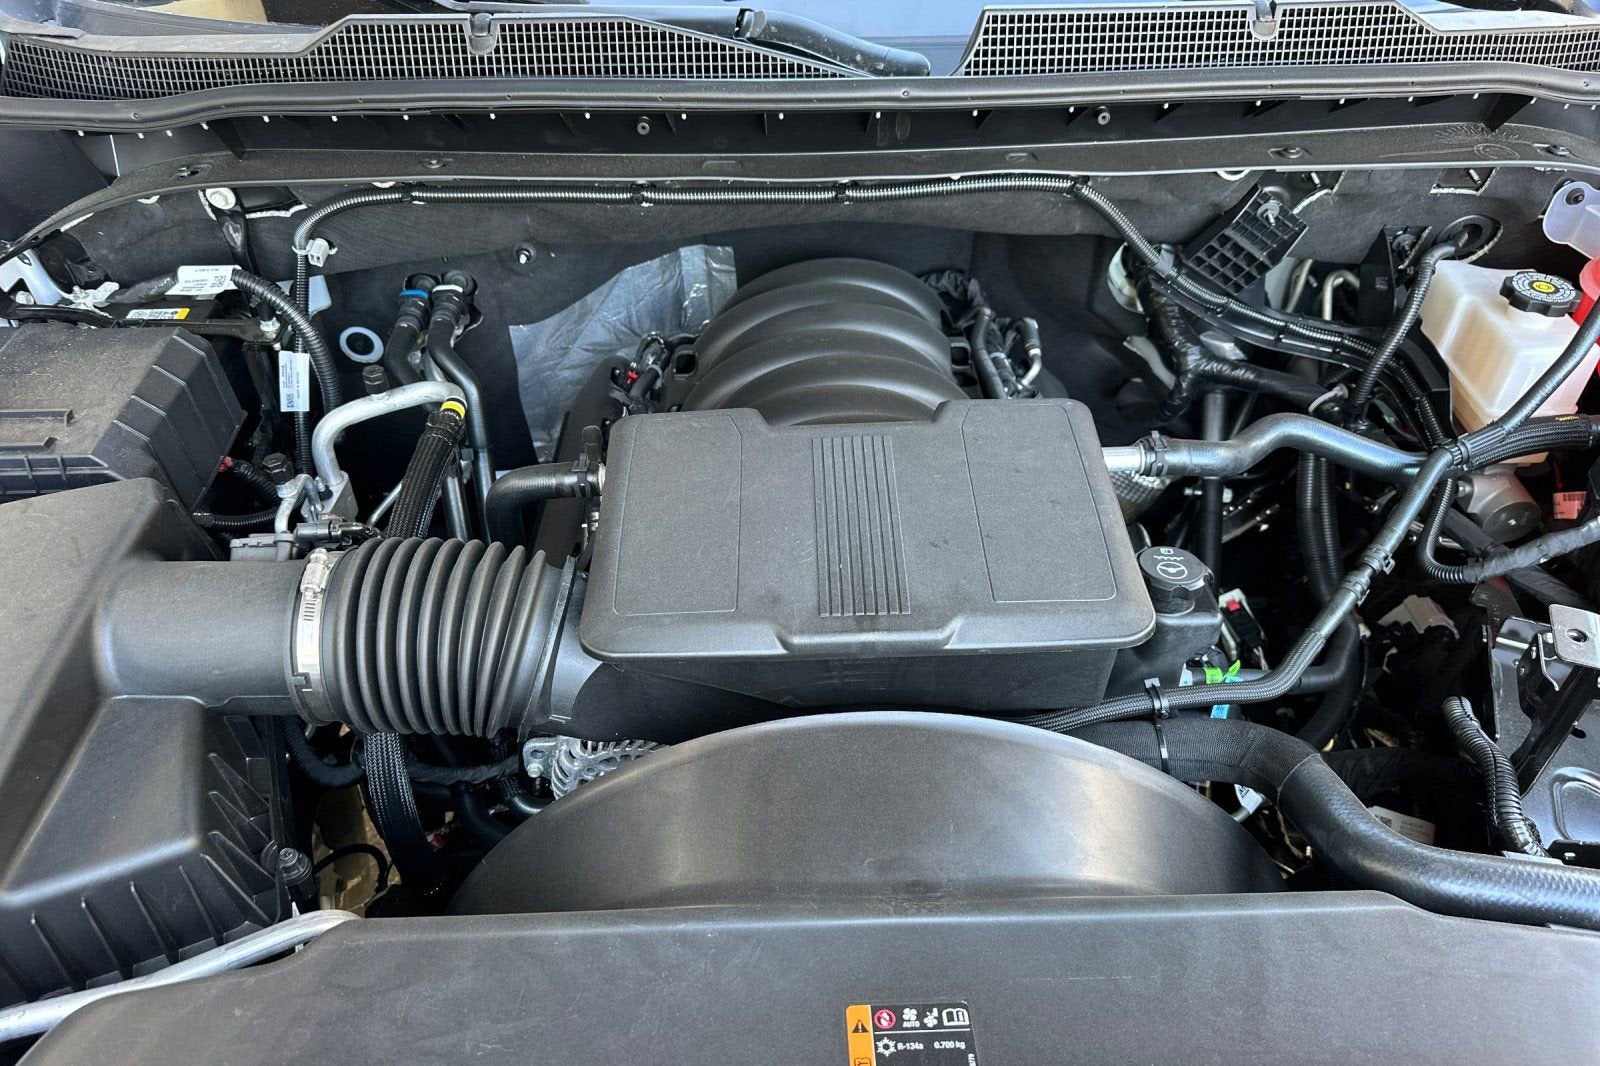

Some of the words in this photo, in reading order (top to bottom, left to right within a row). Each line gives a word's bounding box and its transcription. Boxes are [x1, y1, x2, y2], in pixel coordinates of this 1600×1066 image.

[902, 1020, 920, 1028] AUTO
[933, 1040, 955, 1049] 0.700
[955, 1040, 966, 1050] kg
